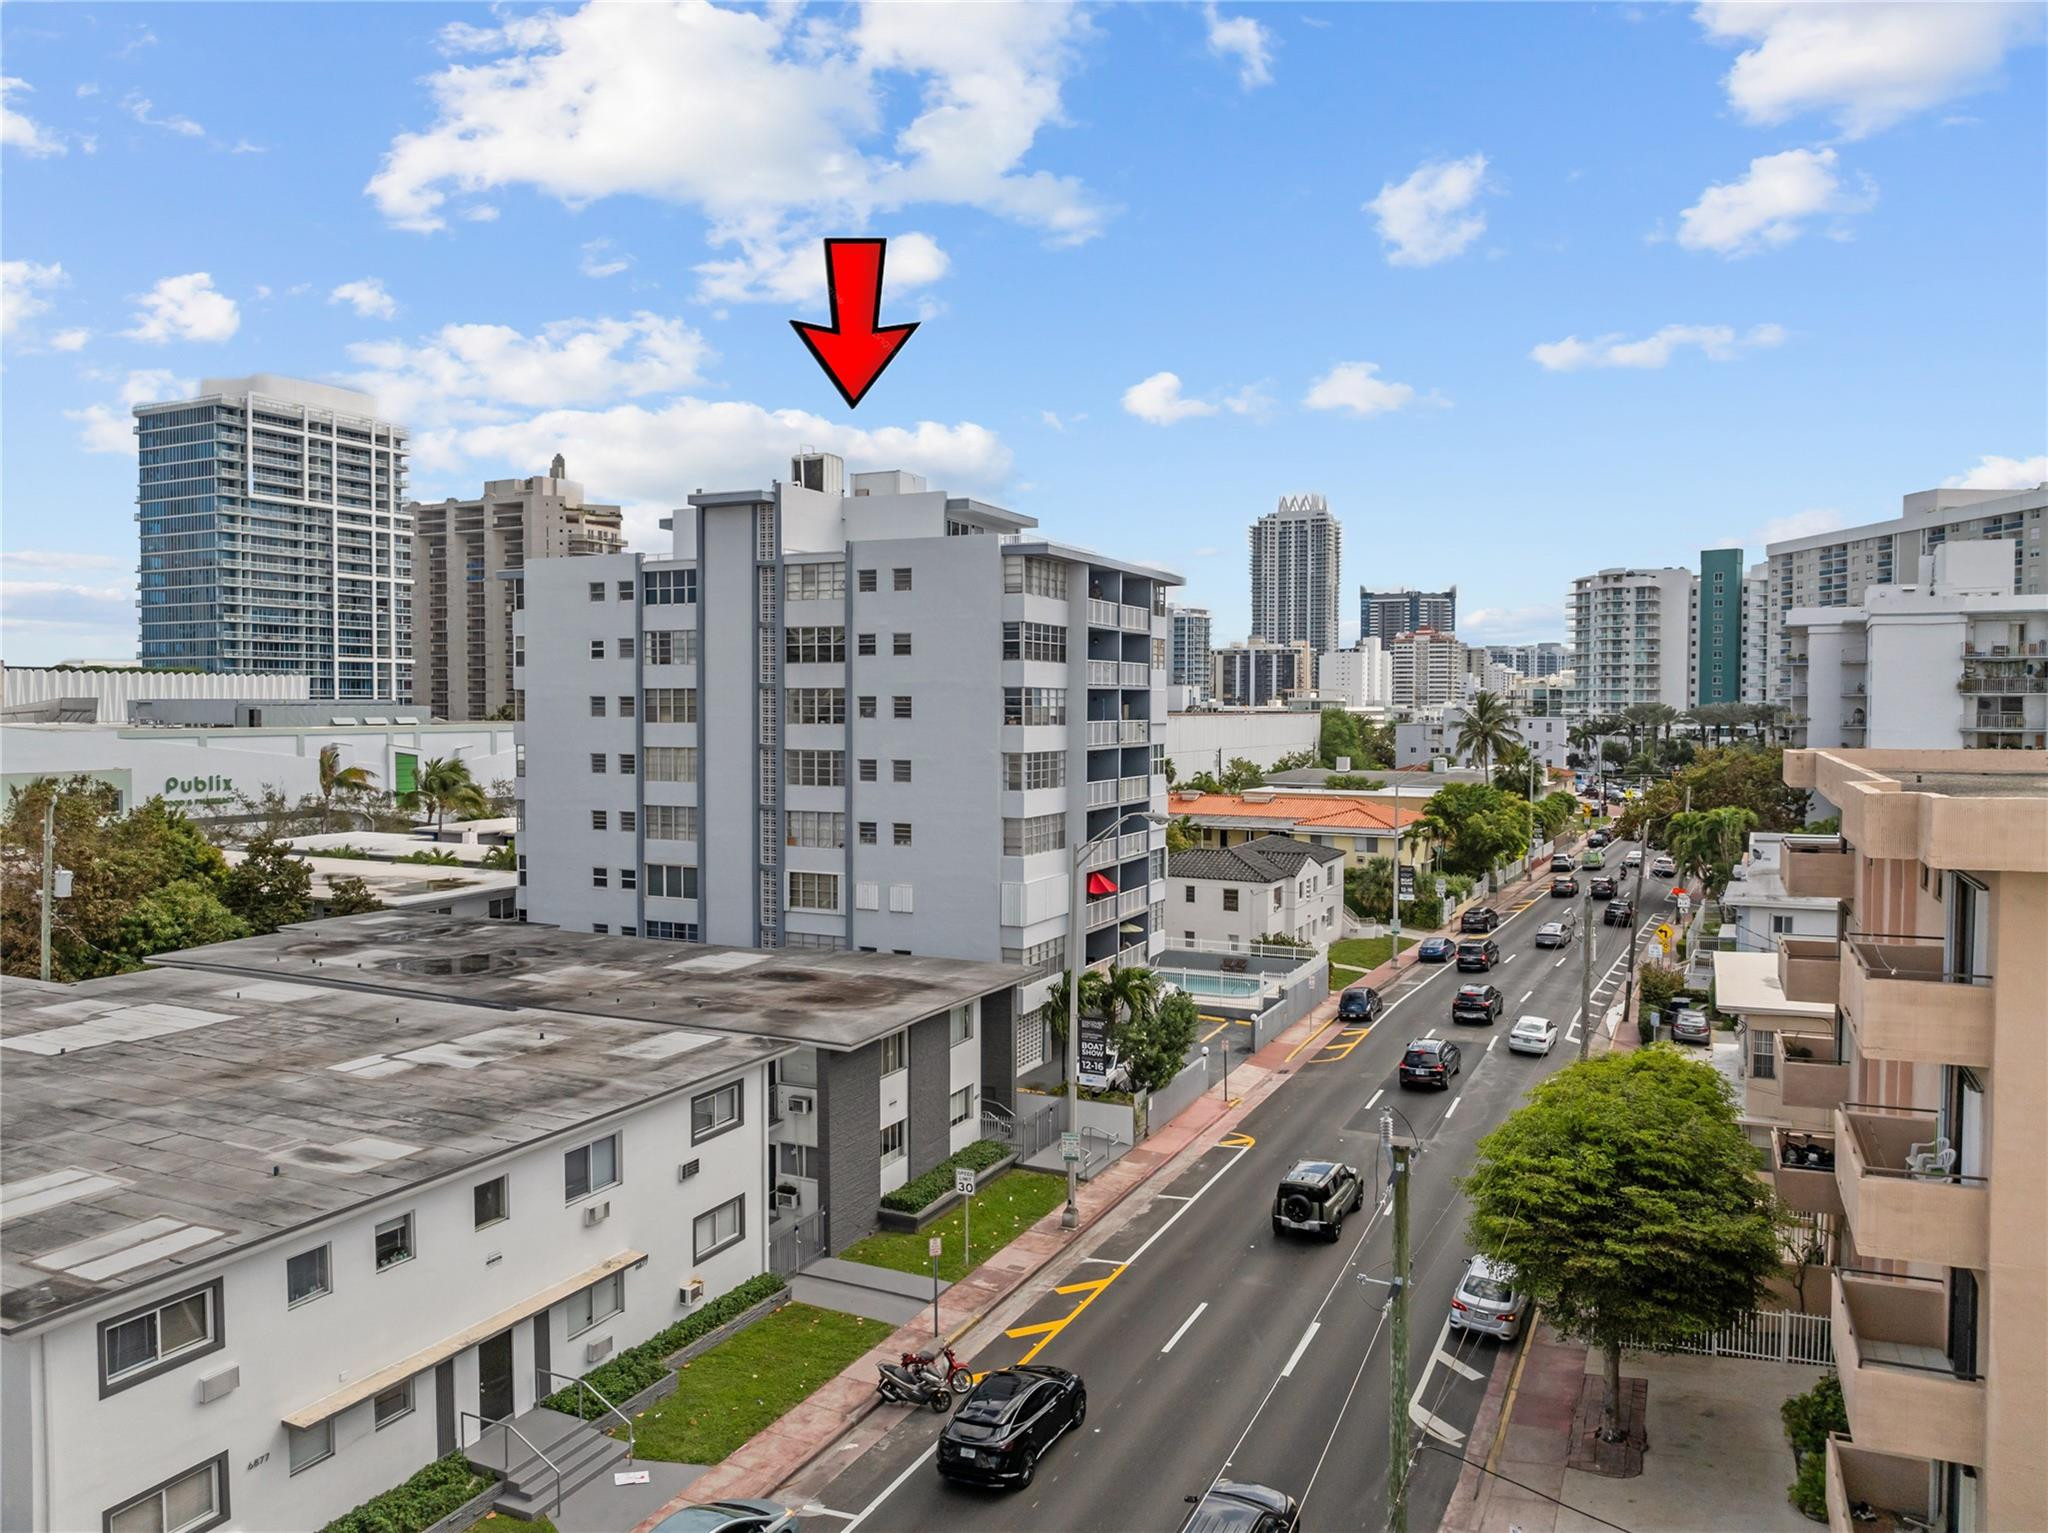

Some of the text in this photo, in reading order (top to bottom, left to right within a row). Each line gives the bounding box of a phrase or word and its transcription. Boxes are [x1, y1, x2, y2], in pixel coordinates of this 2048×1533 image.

[165, 775, 232, 794] Publix
[1081, 1041, 1104, 1051] BOAT
[1081, 1048, 1104, 1058] SHOW
[958, 1181, 974, 1193] 30
